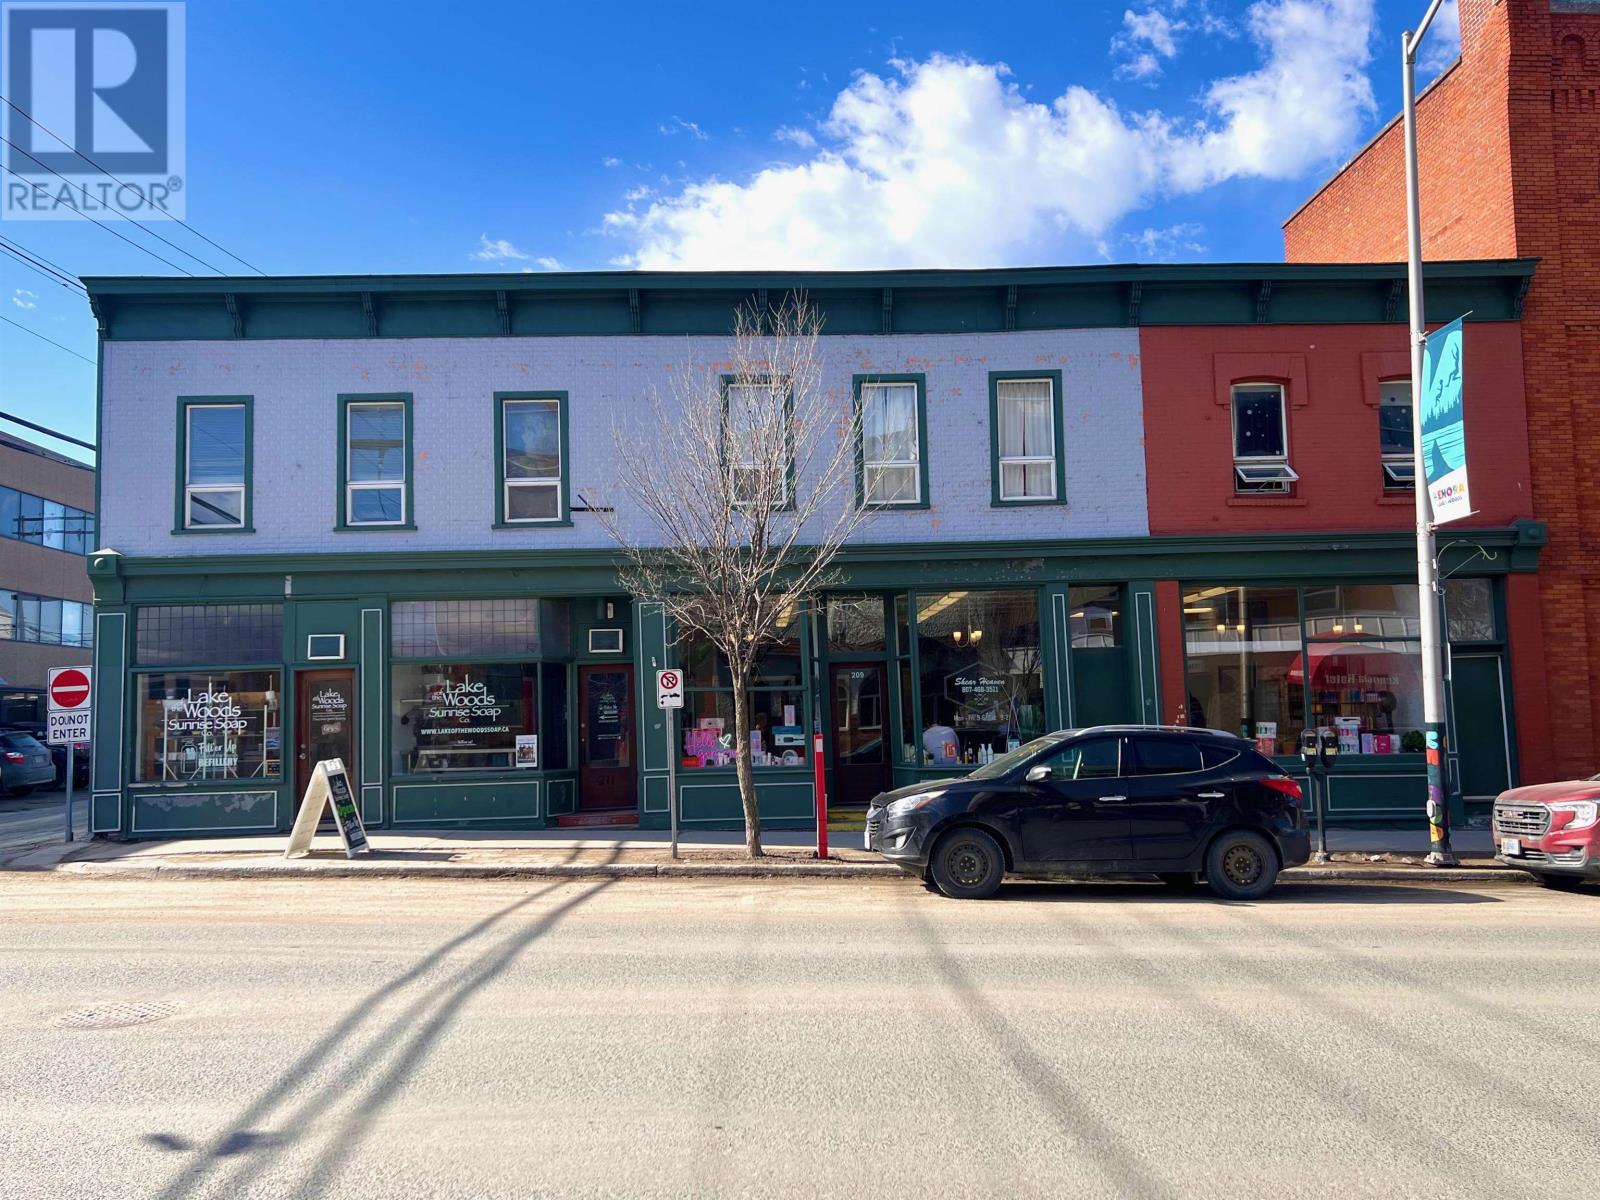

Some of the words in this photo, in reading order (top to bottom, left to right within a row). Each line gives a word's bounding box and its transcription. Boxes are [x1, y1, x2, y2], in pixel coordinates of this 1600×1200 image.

[851, 671, 865, 679] 209
[954, 677, 977, 686] Shear
[978, 676, 1005, 686] Heaven
[446, 674, 484, 694] Lake
[187, 682, 229, 704] Lake
[443, 686, 496, 707] Woods
[183, 696, 241, 718] Woods
[428, 706, 470, 718] Sunrise
[471, 705, 501, 722] Soap
[51, 716, 65, 726] DO
[68, 714, 88, 725] NOT
[167, 717, 213, 731] Sunrise
[214, 717, 247, 736] Soap
[53, 728, 86, 739] ENTER
[421, 726, 510, 735] WWW.LAKEOFTHEWOODSSOAP.CA
